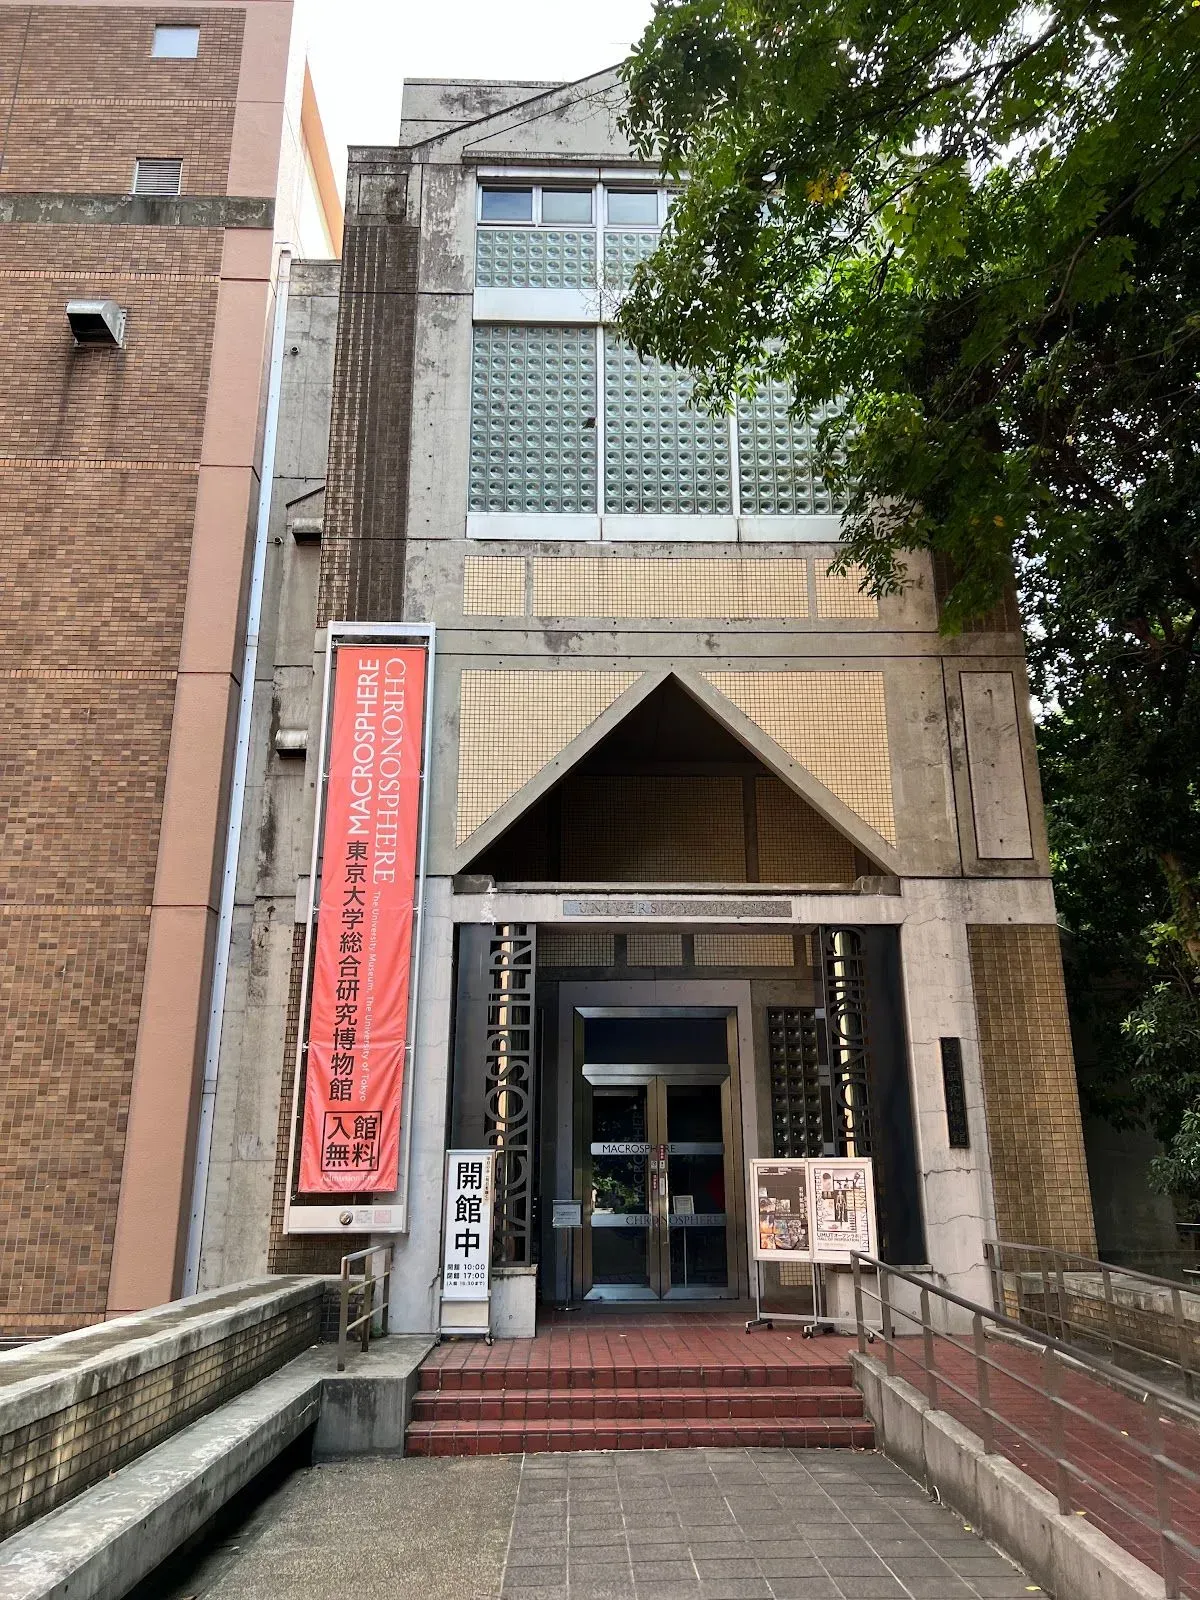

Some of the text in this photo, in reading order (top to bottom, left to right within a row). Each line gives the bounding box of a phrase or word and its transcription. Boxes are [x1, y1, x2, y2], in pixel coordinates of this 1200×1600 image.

[347, 658, 380, 835] MACROSPHERE
[373, 657, 407, 885] CHRONOSPHERE
[328, 839, 369, 1103] 東京大学総合研究博物館
[359, 890, 380, 1102] The University Museum, The University of Tokyo
[823, 926, 872, 1157] CHRONOSP
[325, 1141, 376, 1168] 無料
[326, 1113, 377, 1141] 入館
[454, 1162, 483, 1258] 開館中
[602, 1144, 676, 1154] MACROSPHRE
